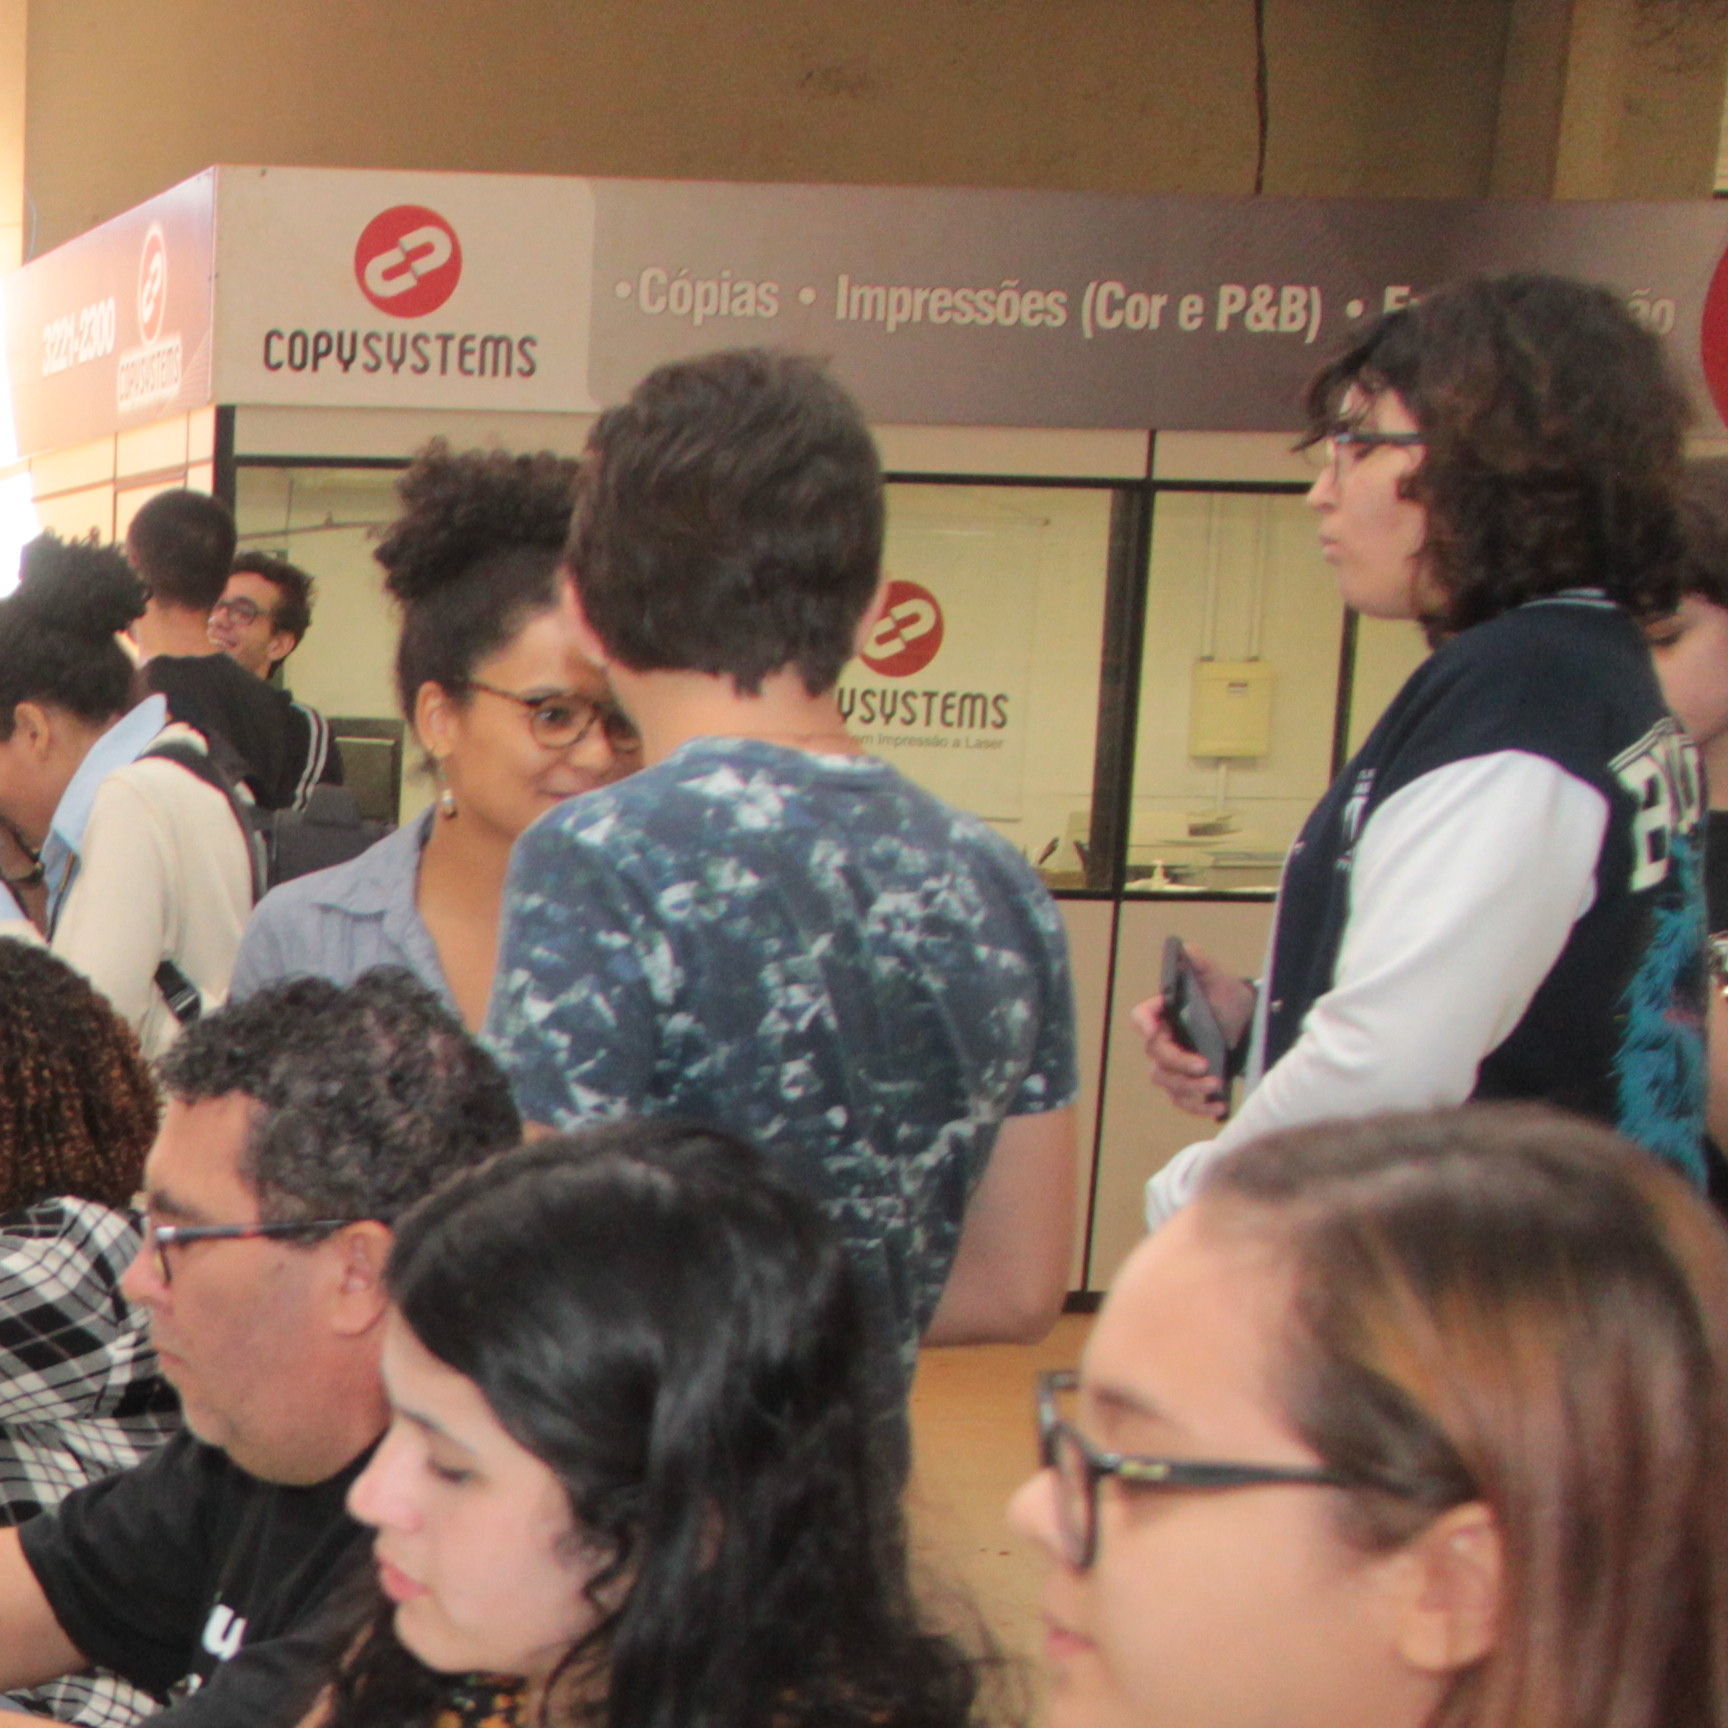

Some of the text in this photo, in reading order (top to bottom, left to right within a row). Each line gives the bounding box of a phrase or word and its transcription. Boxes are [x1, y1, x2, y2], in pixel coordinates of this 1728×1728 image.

[639, 267, 780, 326] Cópias
[835, 274, 1068, 332] Impressões
[1081, 281, 1166, 340] (Cor
[1178, 295, 1202, 331] e
[1216, 284, 1323, 344] P&B)
[262, 329, 538, 379] COPYSYSTEMS
[837, 686, 1010, 730] YSYSTEMS
[877, 733, 948, 750] Impressão
[951, 738, 961, 749] a
[964, 737, 1005, 750] Laser
